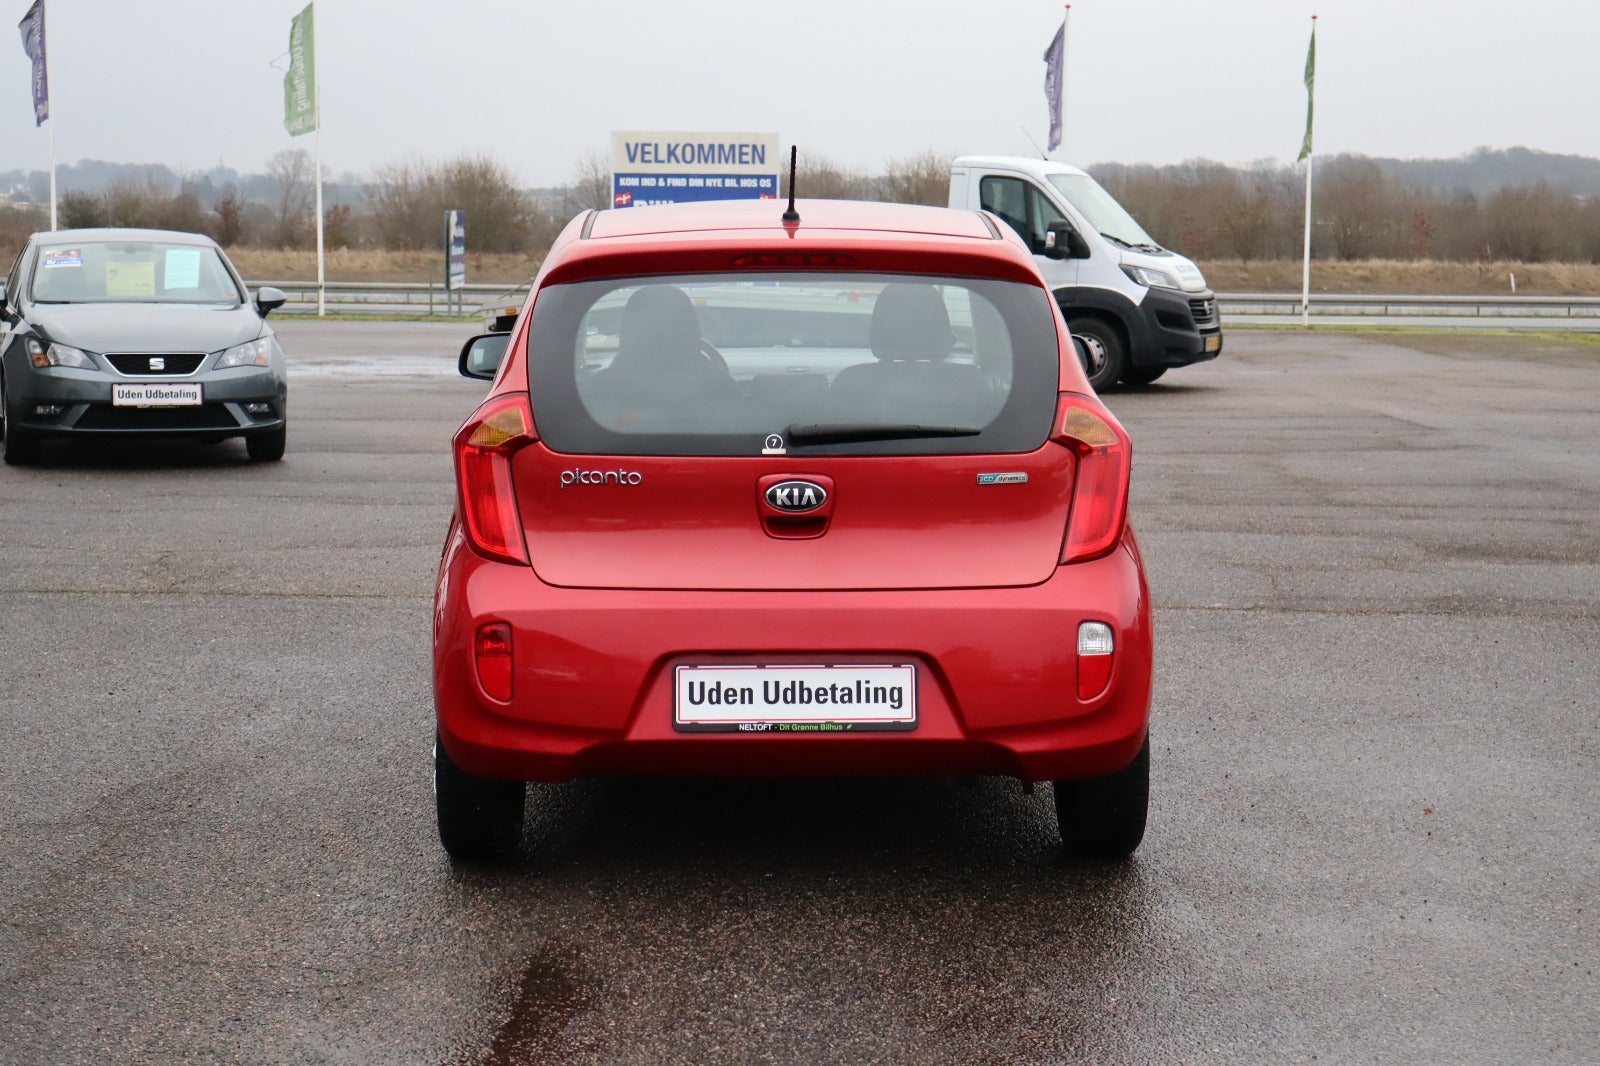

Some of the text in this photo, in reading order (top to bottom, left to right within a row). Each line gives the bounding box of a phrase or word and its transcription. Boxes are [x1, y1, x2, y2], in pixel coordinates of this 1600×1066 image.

[625, 143, 765, 164] VELKOMMEN
[619, 177, 639, 186] KOM
[641, 177, 656, 186] IND
[667, 178, 687, 187] FIND
[689, 178, 704, 187] DIN
[706, 178, 722, 187] NYE
[724, 178, 738, 187] BIL
[740, 178, 758, 187] HOS
[759, 179, 772, 188] OS
[117, 389, 197, 400] Uden Udbetaling
[771, 438, 778, 447] 7
[560, 468, 642, 489] picanto
[776, 488, 817, 506] KIA
[688, 680, 903, 710] Uden Udbetaling
[739, 723, 772, 731] NELTOFT
[780, 723, 790, 731] Dit
[820, 723, 843, 731] Bilhus
